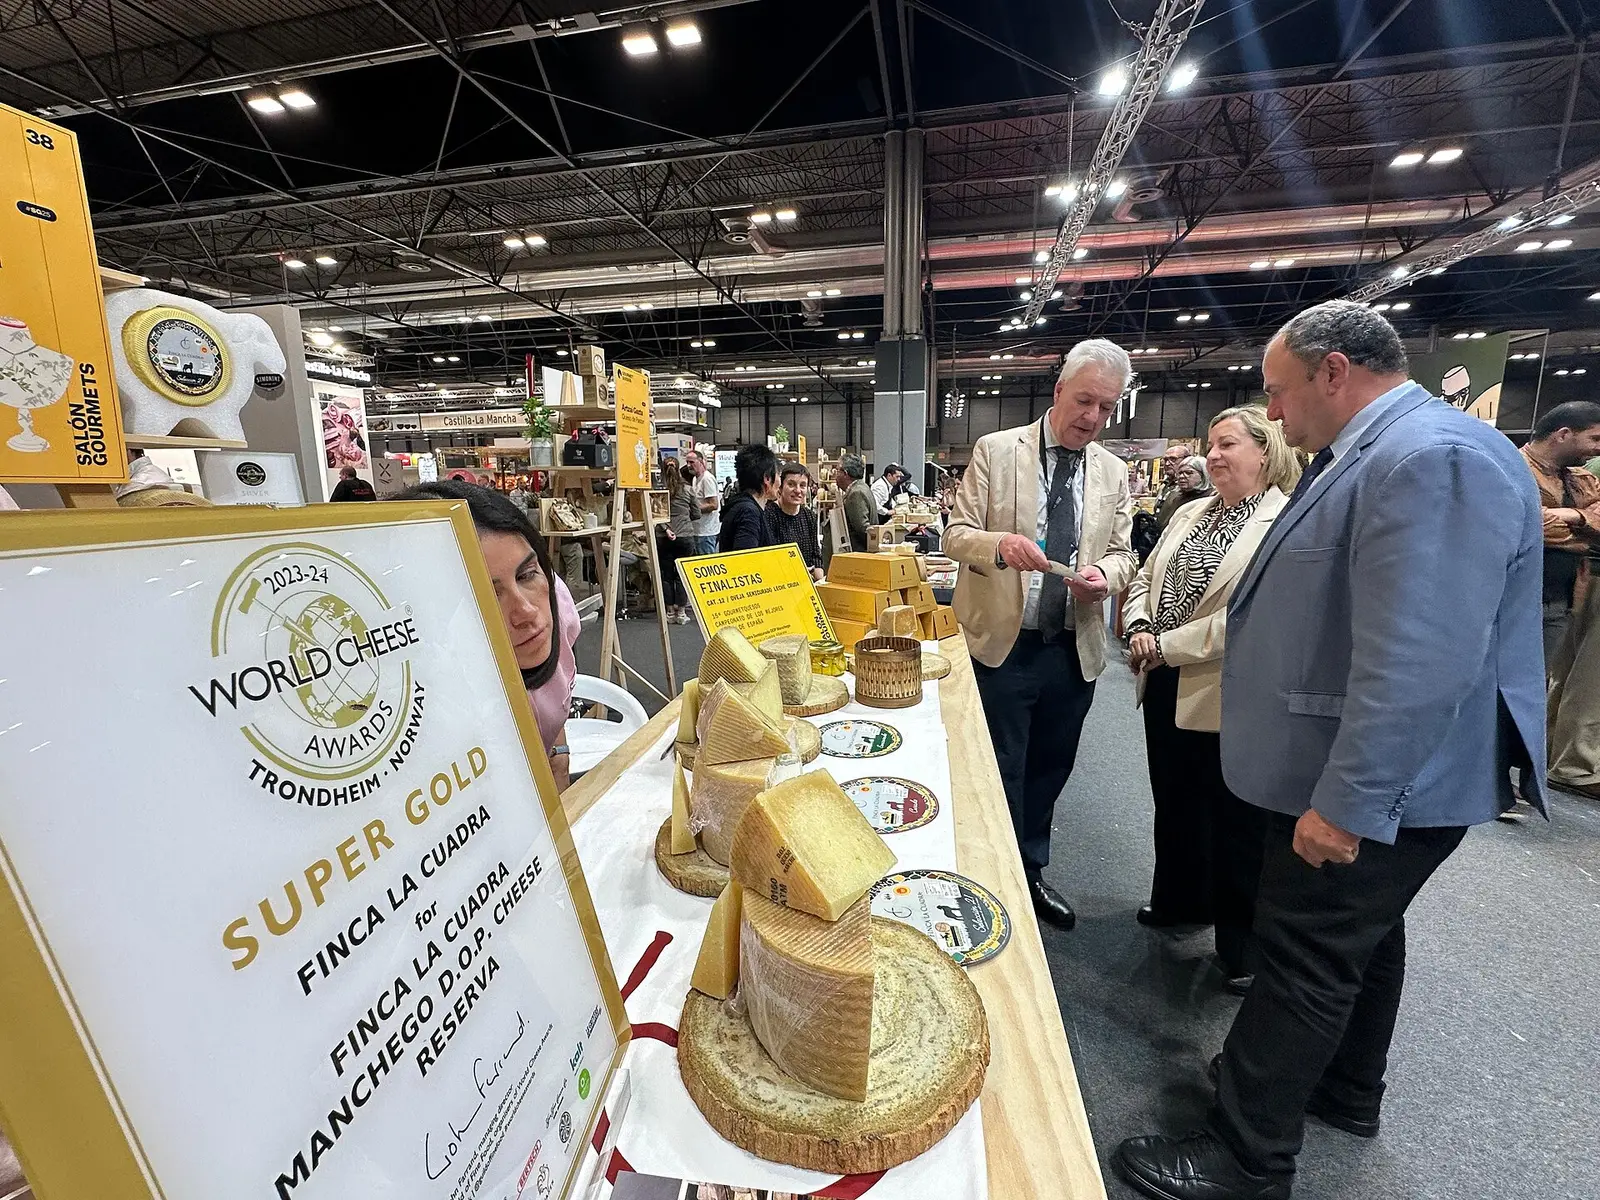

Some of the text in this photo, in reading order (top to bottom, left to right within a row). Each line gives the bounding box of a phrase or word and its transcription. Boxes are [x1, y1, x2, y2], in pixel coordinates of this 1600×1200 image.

[26, 128, 55, 150] 38
[68, 403, 93, 467] SALÓN
[79, 362, 108, 467] GOURMETS
[487, 413, 517, 424] Mancha
[694, 564, 728, 578] SOMOS
[788, 550, 796, 558] 38
[264, 565, 330, 594] 2023-24
[700, 572, 762, 594] FINALISTAS
[730, 594, 745, 602] OVEJA
[746, 587, 773, 598] SEMICURADO
[724, 602, 760, 617] GOURMETQUESOS
[746, 612, 753, 620] DE
[755, 610, 764, 618] LOS
[765, 606, 784, 616] MEJORES
[810, 595, 832, 641] OURMETS
[814, 616, 828, 641] ALÓN
[188, 618, 419, 717] WORLD CHEESE
[248, 680, 426, 807] TRONDHEIM NORWAY
[304, 699, 393, 758] AWARDS
[221, 746, 488, 972] SUPER GOLD
[296, 804, 492, 997] FINCA LA CUADRA
[414, 901, 439, 933] for
[329, 861, 511, 1078] FINCA LA CUADRA
[272, 855, 544, 1200] MANCHEGO D.O.P. CHEESE
[414, 956, 501, 1078] RESERVA
[470, 1162, 481, 1182] Fine
[494, 1100, 514, 1138] organisers
[517, 1066, 530, 1090] World
[528, 1045, 542, 1068] Cheese
[478, 1113, 498, 1151] managing
